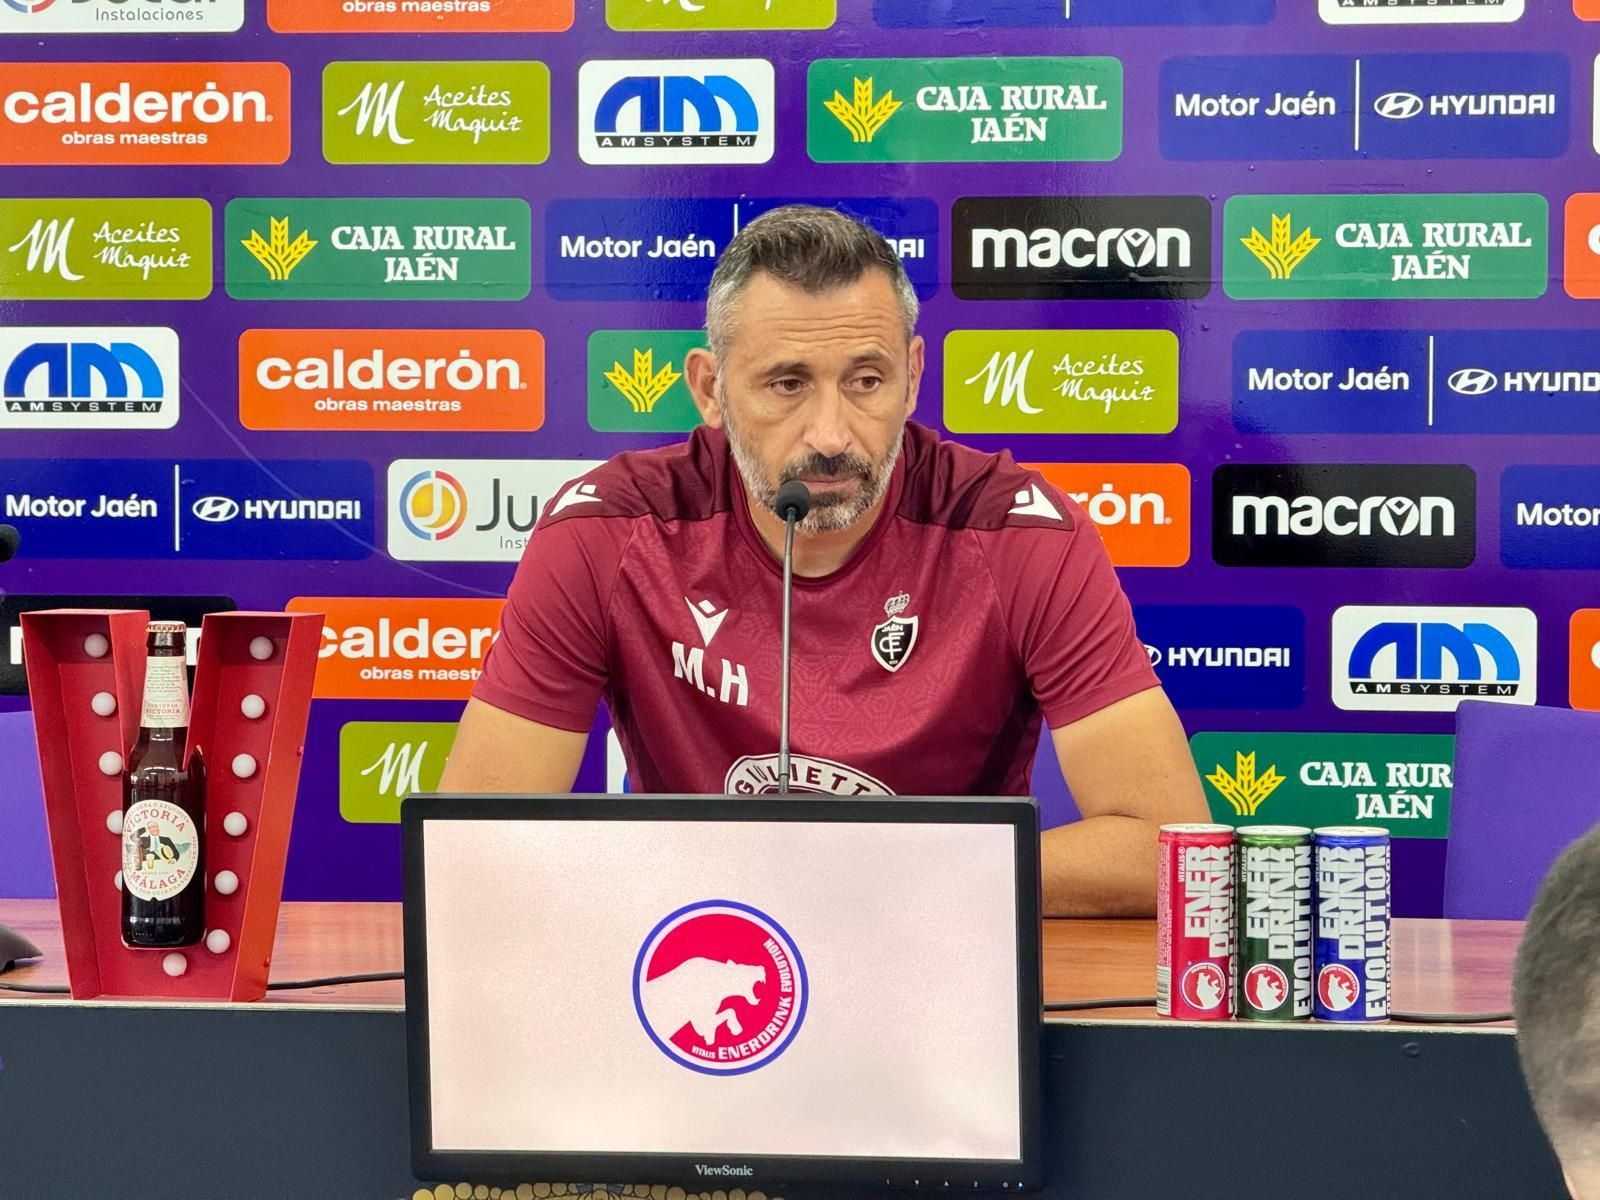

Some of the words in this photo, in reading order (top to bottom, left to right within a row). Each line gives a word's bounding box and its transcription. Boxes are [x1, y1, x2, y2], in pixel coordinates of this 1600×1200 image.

[96, 8, 203, 20] Instalaciones
[402, 0, 490, 12] maestras
[423, 84, 511, 107] Aceites
[916, 86, 991, 112] CAJA
[1001, 85, 1107, 110] RURAL
[1176, 94, 1259, 116] Motor
[1265, 91, 1335, 115] Jaén
[1431, 95, 1554, 115] HYUNDAI
[62, 132, 115, 144] obras
[120, 132, 207, 144] maestras
[971, 113, 1047, 143] JAÉN
[93, 221, 181, 243] Aceites
[331, 226, 404, 251] CAJA
[413, 226, 515, 250] RURAL
[1336, 223, 1412, 249] CAJA
[1423, 223, 1531, 247] RURAL
[561, 236, 642, 257] Motor
[648, 234, 715, 257] Jaén
[972, 228, 1190, 267] macron
[385, 253, 458, 282] JAÉN
[1392, 250, 1470, 281] JAÉN
[1053, 353, 1144, 376] Aceites
[1249, 368, 1333, 390] Motor
[1338, 366, 1409, 390] Jaén
[315, 398, 368, 411] obras
[373, 399, 461, 411] maestras
[7, 495, 86, 517] Motor
[91, 494, 157, 517] Jaén
[245, 500, 360, 519] HYUNDAI
[1233, 496, 1454, 536] macron
[1169, 648, 1289, 666] HYUNDAI
[360, 667, 413, 680] obras
[1300, 762, 1376, 788] CAJA
[1356, 790, 1433, 819] JAÉN
[125, 808, 186, 833] VICTORIA
[131, 868, 186, 889] MÁLAGA
[1184, 846, 1210, 938] ENER
[1246, 846, 1270, 939] ENER
[1319, 846, 1340, 939] ENER
[1293, 845, 1311, 1017] EVOLUTION
[1364, 846, 1386, 1018] EVOLUTION
[718, 996, 793, 1060] ENERDRINK
[763, 938, 793, 993] EVOLUTION
[695, 1164, 754, 1180] ViewSonic
